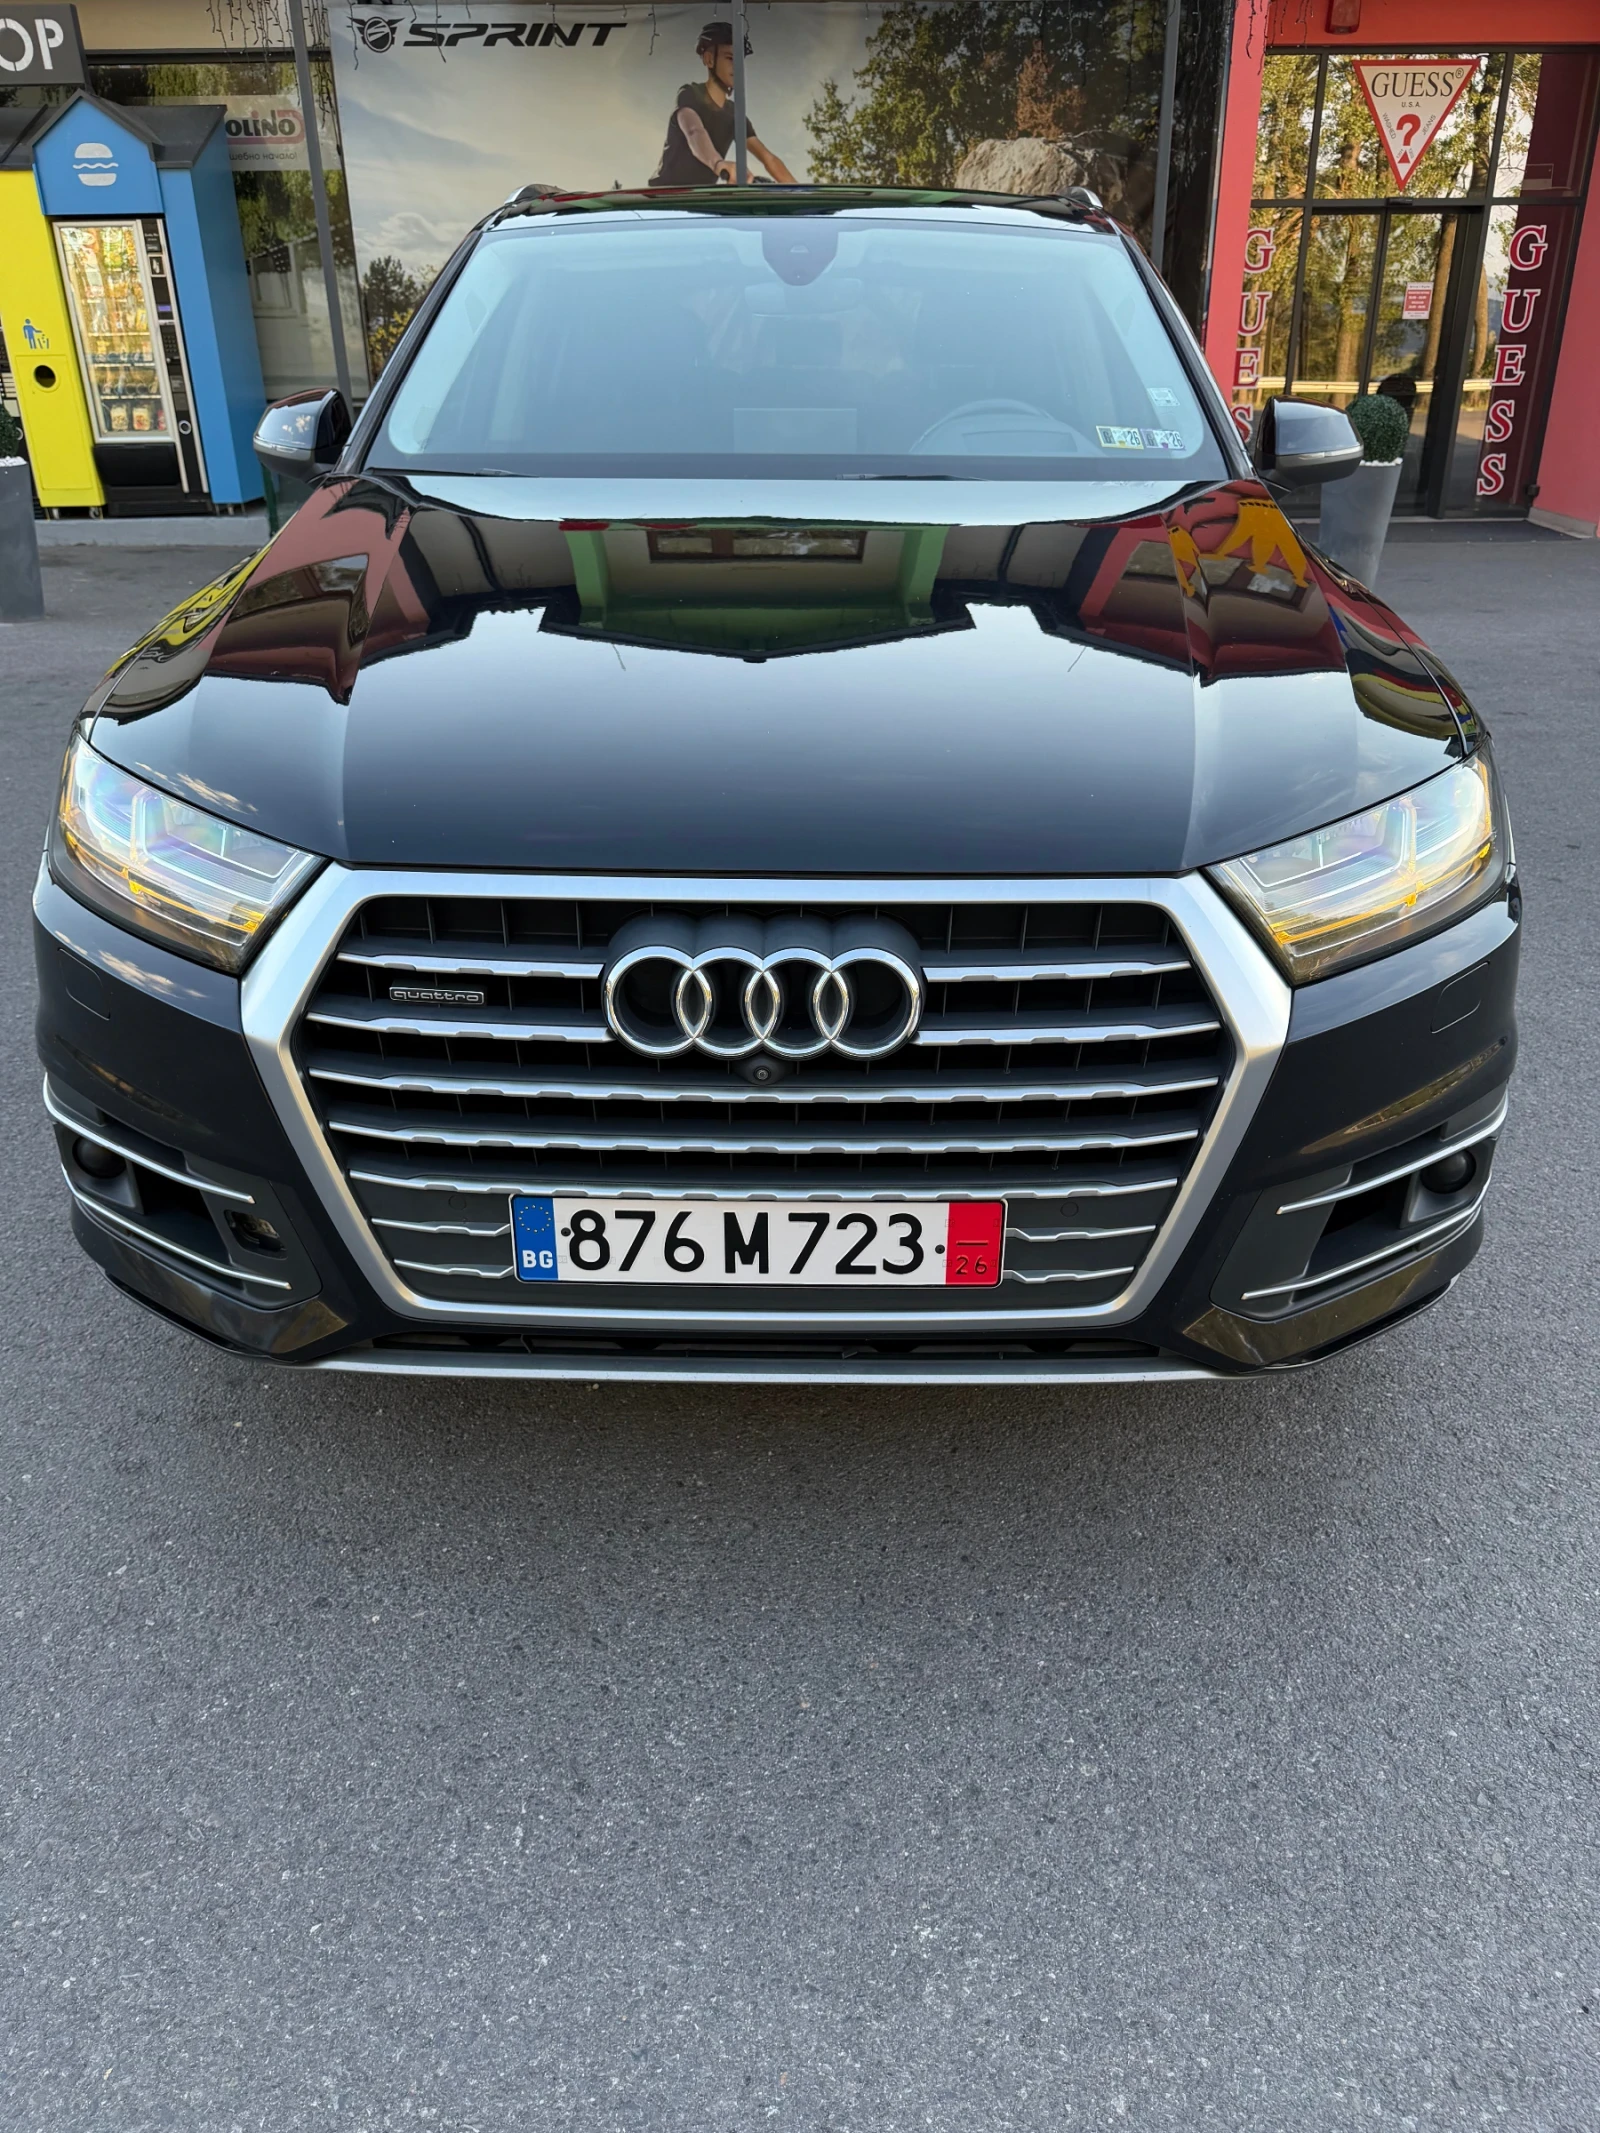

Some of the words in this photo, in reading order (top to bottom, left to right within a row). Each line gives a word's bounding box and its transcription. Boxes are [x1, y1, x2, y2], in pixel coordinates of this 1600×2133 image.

[0, 18, 64, 72] OP
[403, 22, 628, 48] SPRINT
[1382, 112, 1396, 140] WASHED
[1421, 114, 1437, 136] JEANS
[1476, 224, 1548, 496] GUESS
[394, 991, 479, 1001] quattro
[568, 1209, 705, 1273] 876
[723, 1211, 769, 1274] M
[787, 1213, 924, 1275] 723
[522, 1249, 554, 1269] BG
[955, 1254, 988, 1275] 26
